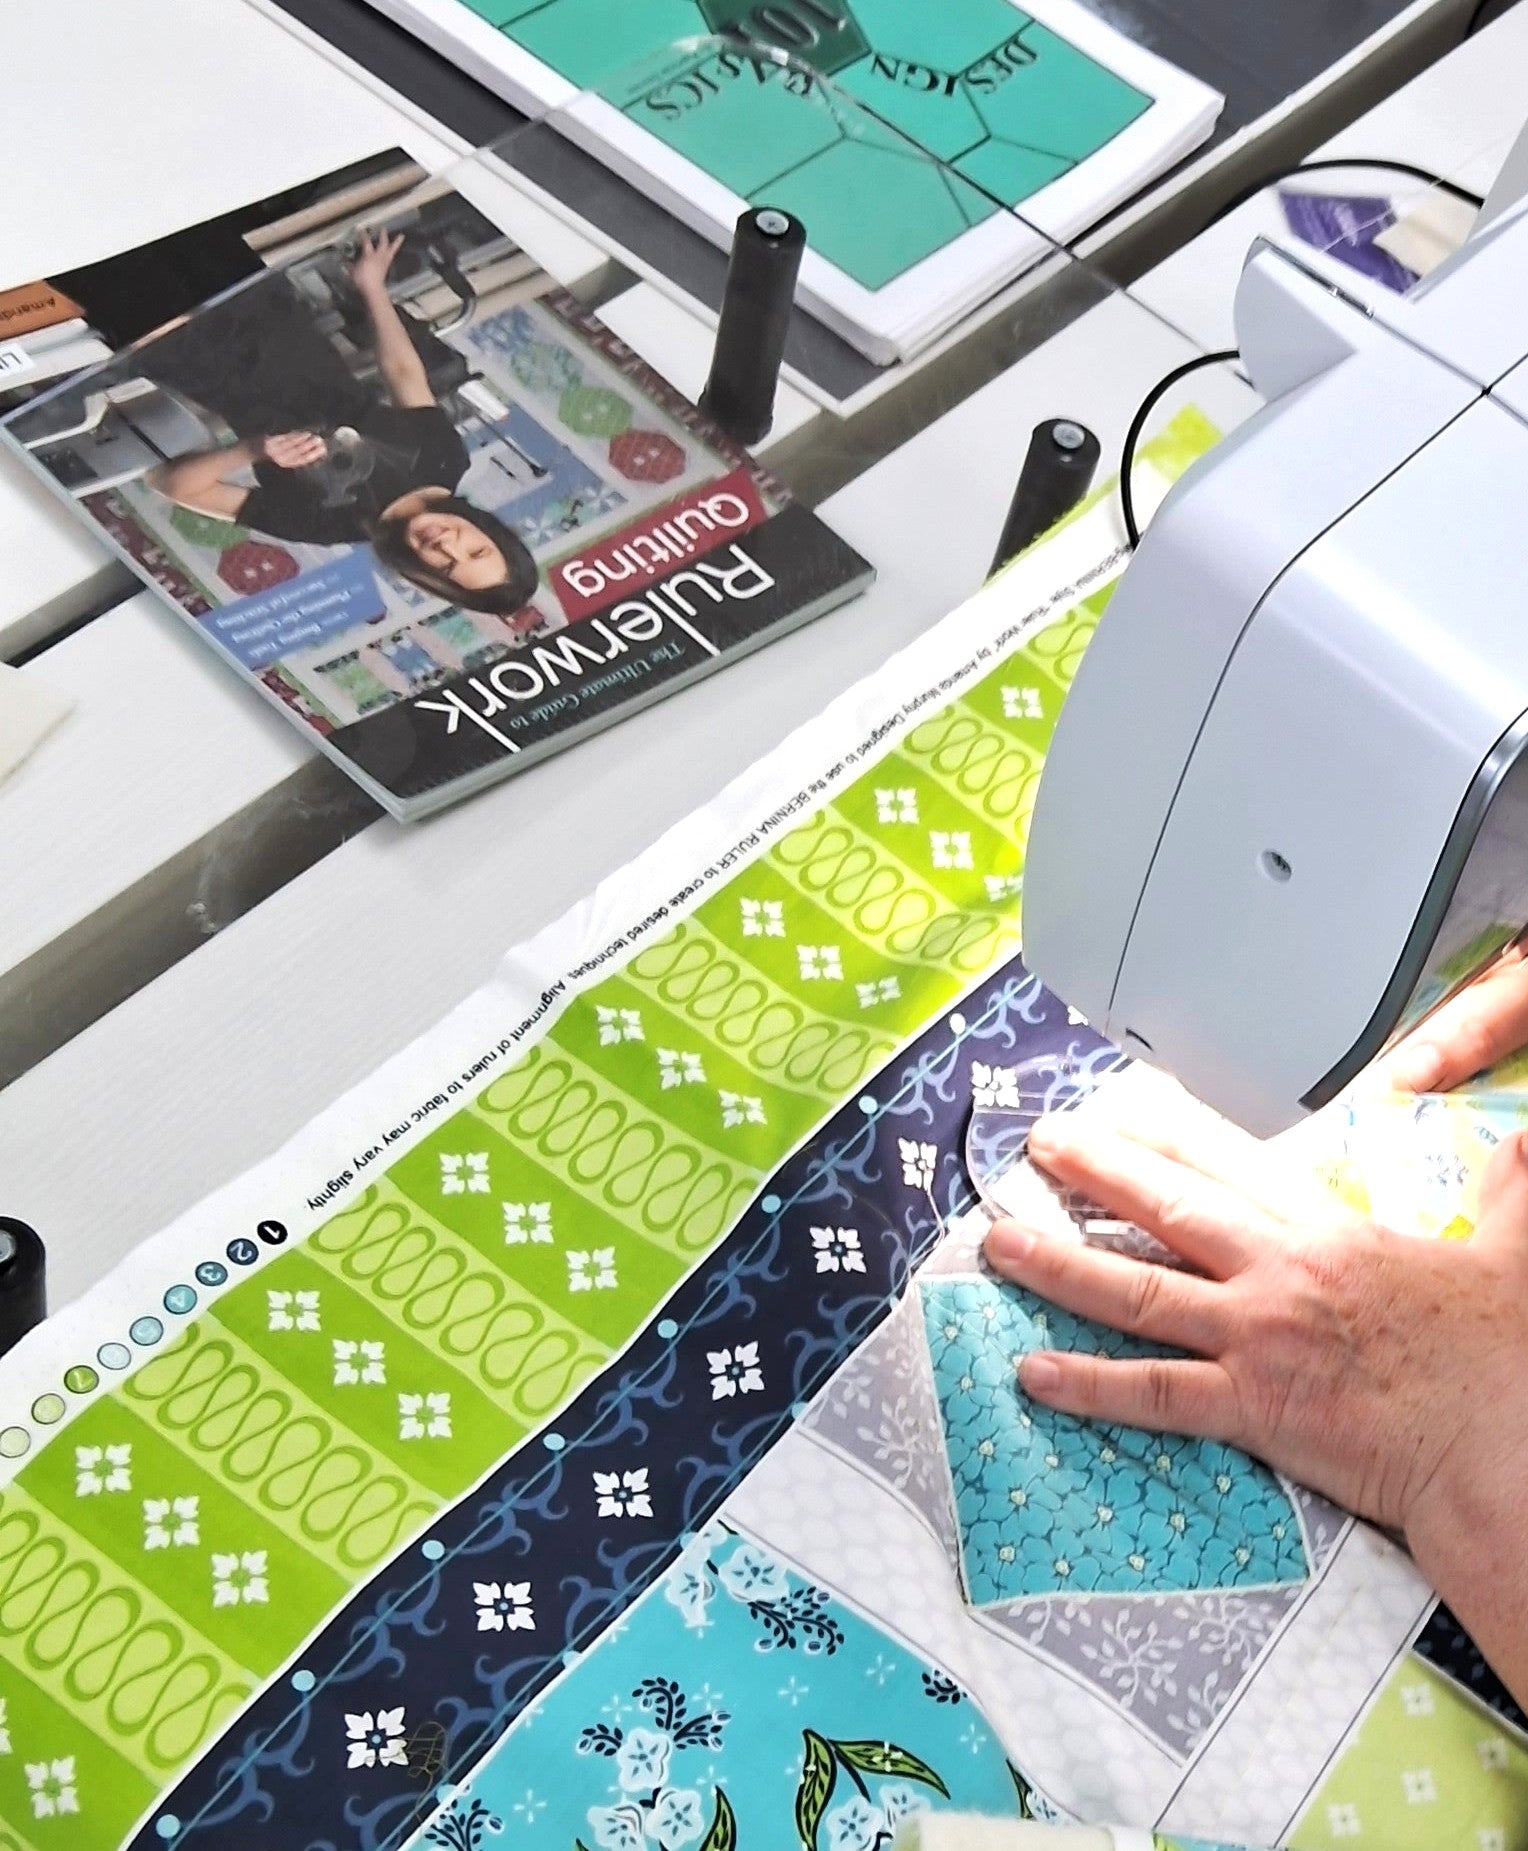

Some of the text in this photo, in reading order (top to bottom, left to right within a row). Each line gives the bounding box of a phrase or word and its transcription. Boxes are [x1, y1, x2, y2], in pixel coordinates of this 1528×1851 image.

[870, 34, 1038, 98] DESIGN
[561, 492, 750, 598] Quilting
[414, 543, 776, 753] Rulerwork
[975, 647, 993, 661] by
[509, 639, 685, 729] The Ultimate Guide to
[856, 713, 906, 757] Designed
[825, 762, 845, 781] use
[844, 753, 860, 765] to
[807, 779, 828, 794] the
[755, 791, 811, 835] BERNINA
[715, 832, 761, 870] RULER
[703, 866, 720, 879] to
[668, 878, 705, 907] create
[626, 906, 669, 942] desired
[509, 979, 566, 1042] Alignment
[496, 1039, 511, 1056] of
[461, 1050, 498, 1083] rulers
[446, 1080, 464, 1095] to
[410, 1093, 450, 1123] fabric
[381, 1120, 412, 1147] may
[352, 1145, 384, 1171] vary
